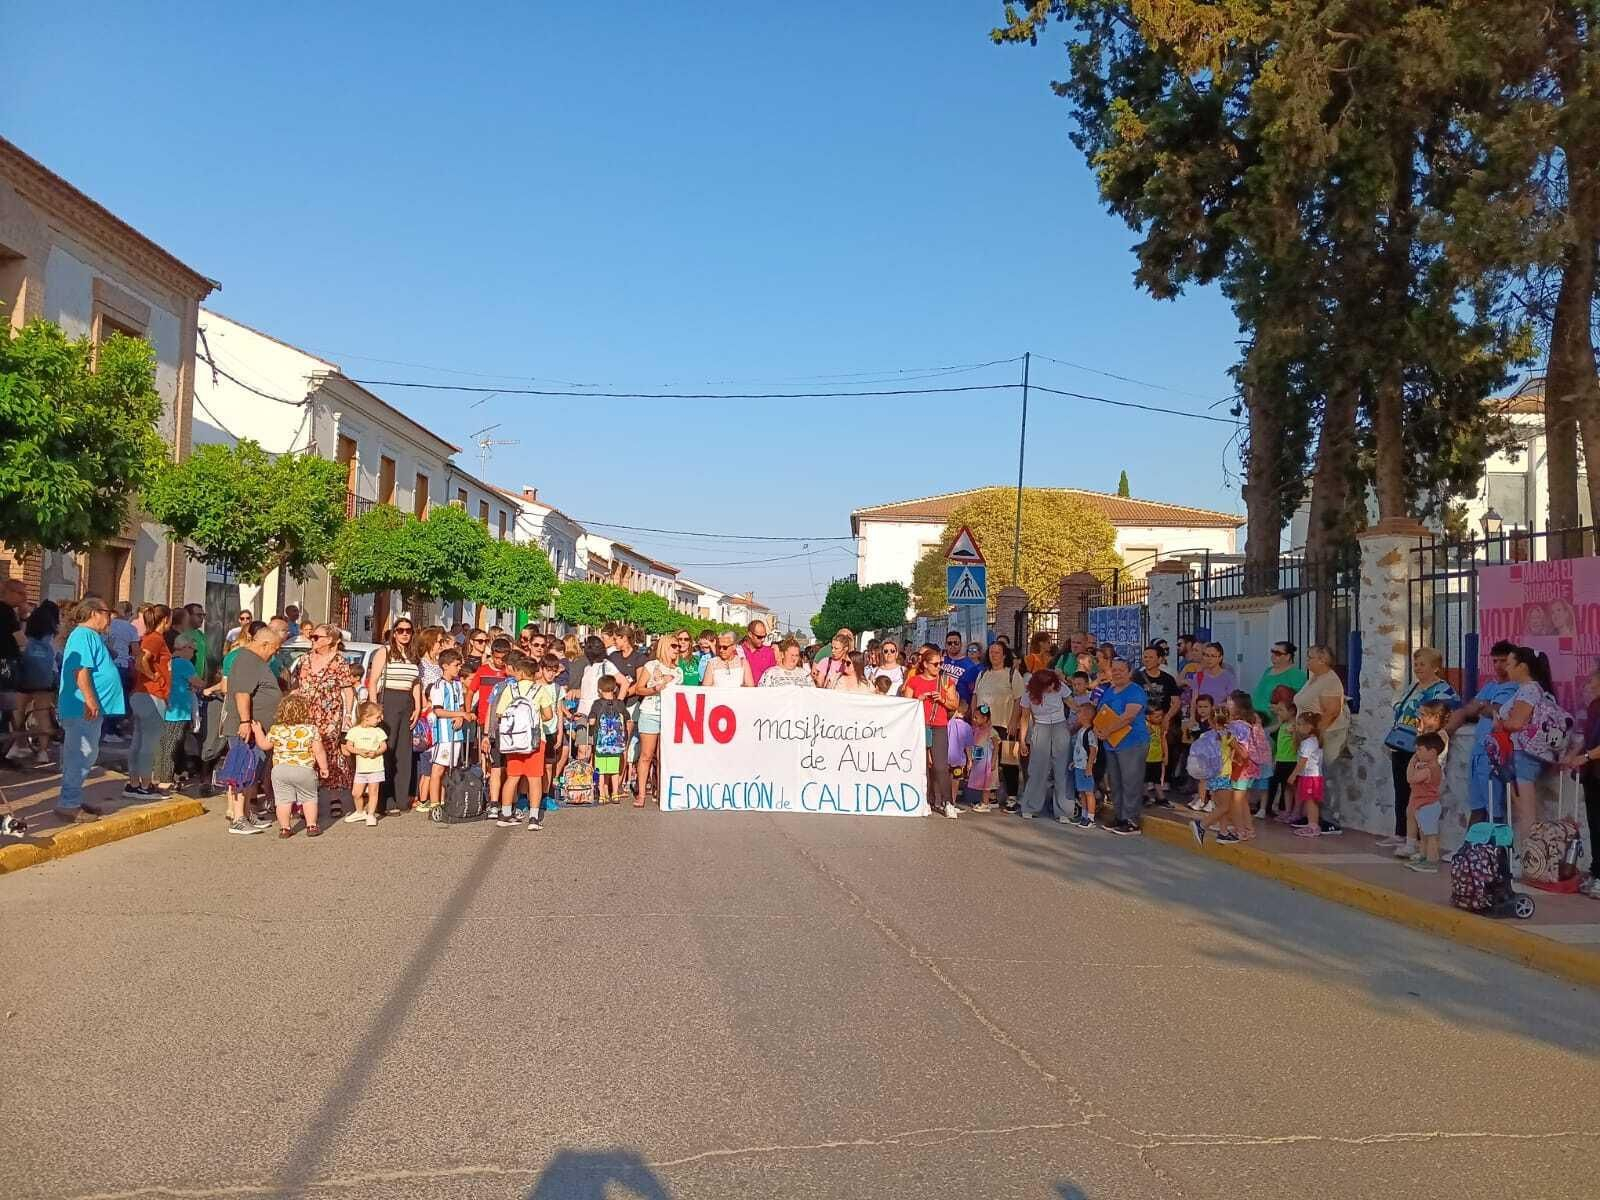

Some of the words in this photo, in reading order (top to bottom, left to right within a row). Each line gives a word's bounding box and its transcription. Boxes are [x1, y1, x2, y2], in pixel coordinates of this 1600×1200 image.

[1480, 606, 1524, 637] VOTA
[754, 714, 887, 746] masificación
[800, 744, 827, 771] de
[838, 744, 913, 773] AULAS
[668, 775, 774, 811] EDUCACIÓN
[775, 788, 793, 810] de
[800, 782, 921, 813] CALIDAD
